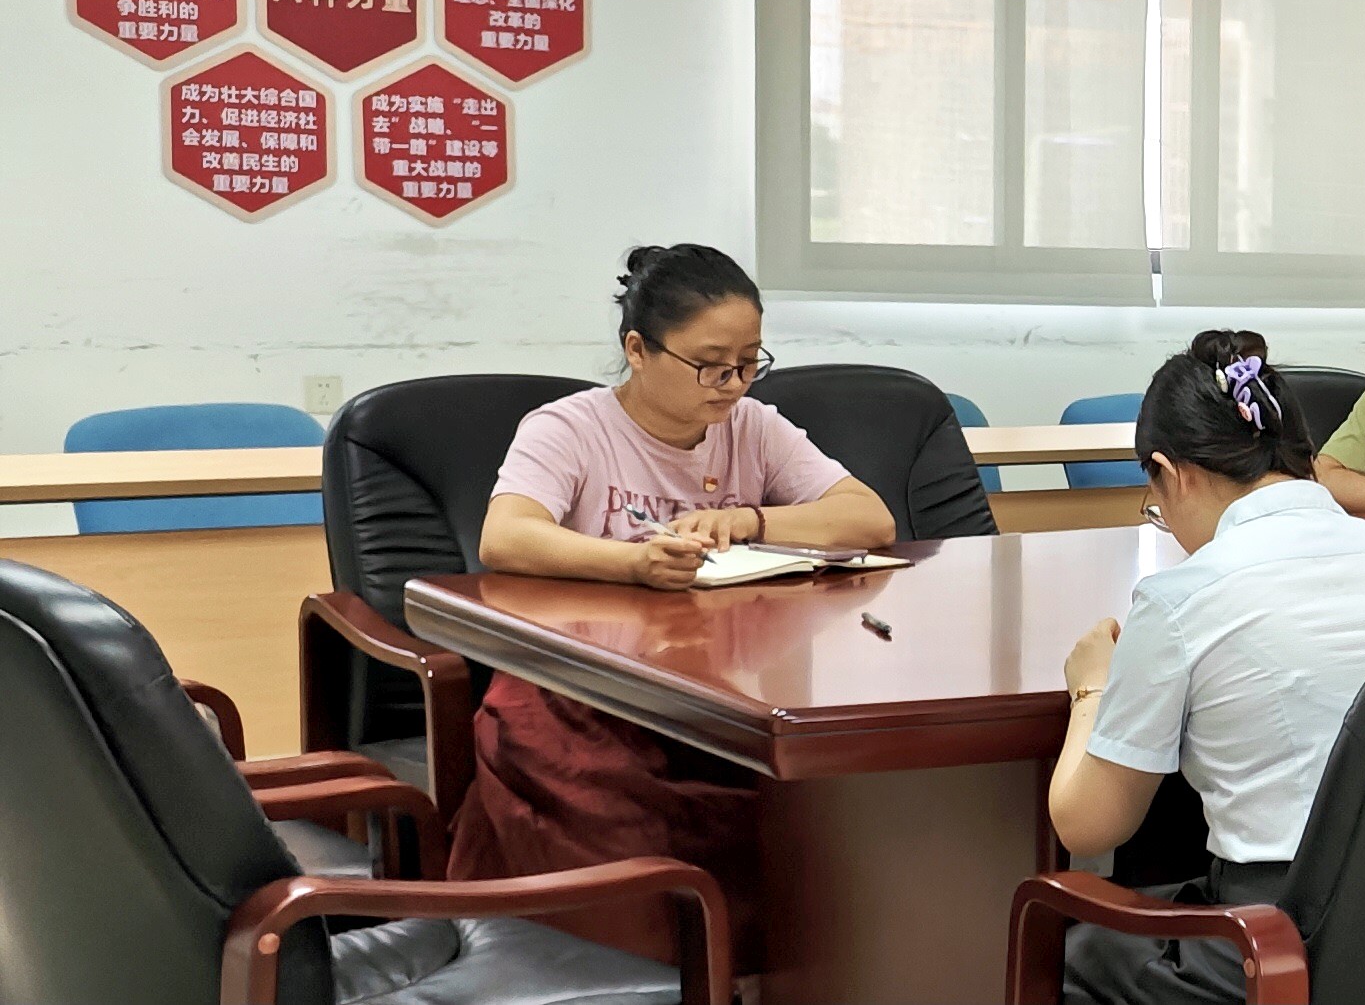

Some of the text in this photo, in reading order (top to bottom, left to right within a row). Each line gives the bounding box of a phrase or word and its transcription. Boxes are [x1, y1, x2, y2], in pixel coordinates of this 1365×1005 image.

[489, 9, 541, 30] 改革的
[117, 21, 199, 42] 重要力量
[481, 30, 550, 52] 重要力量
[181, 83, 317, 108] 成为壮大综合国
[372, 94, 497, 115] 成为实施“走出
[181, 105, 318, 130] 力、促进经济社
[182, 127, 318, 151] 会发展、保障和
[202, 151, 299, 173] 改善民生的
[392, 159, 481, 178] 重大战略的
[212, 174, 289, 194] 重要力量
[402, 181, 473, 199] 重要力量
